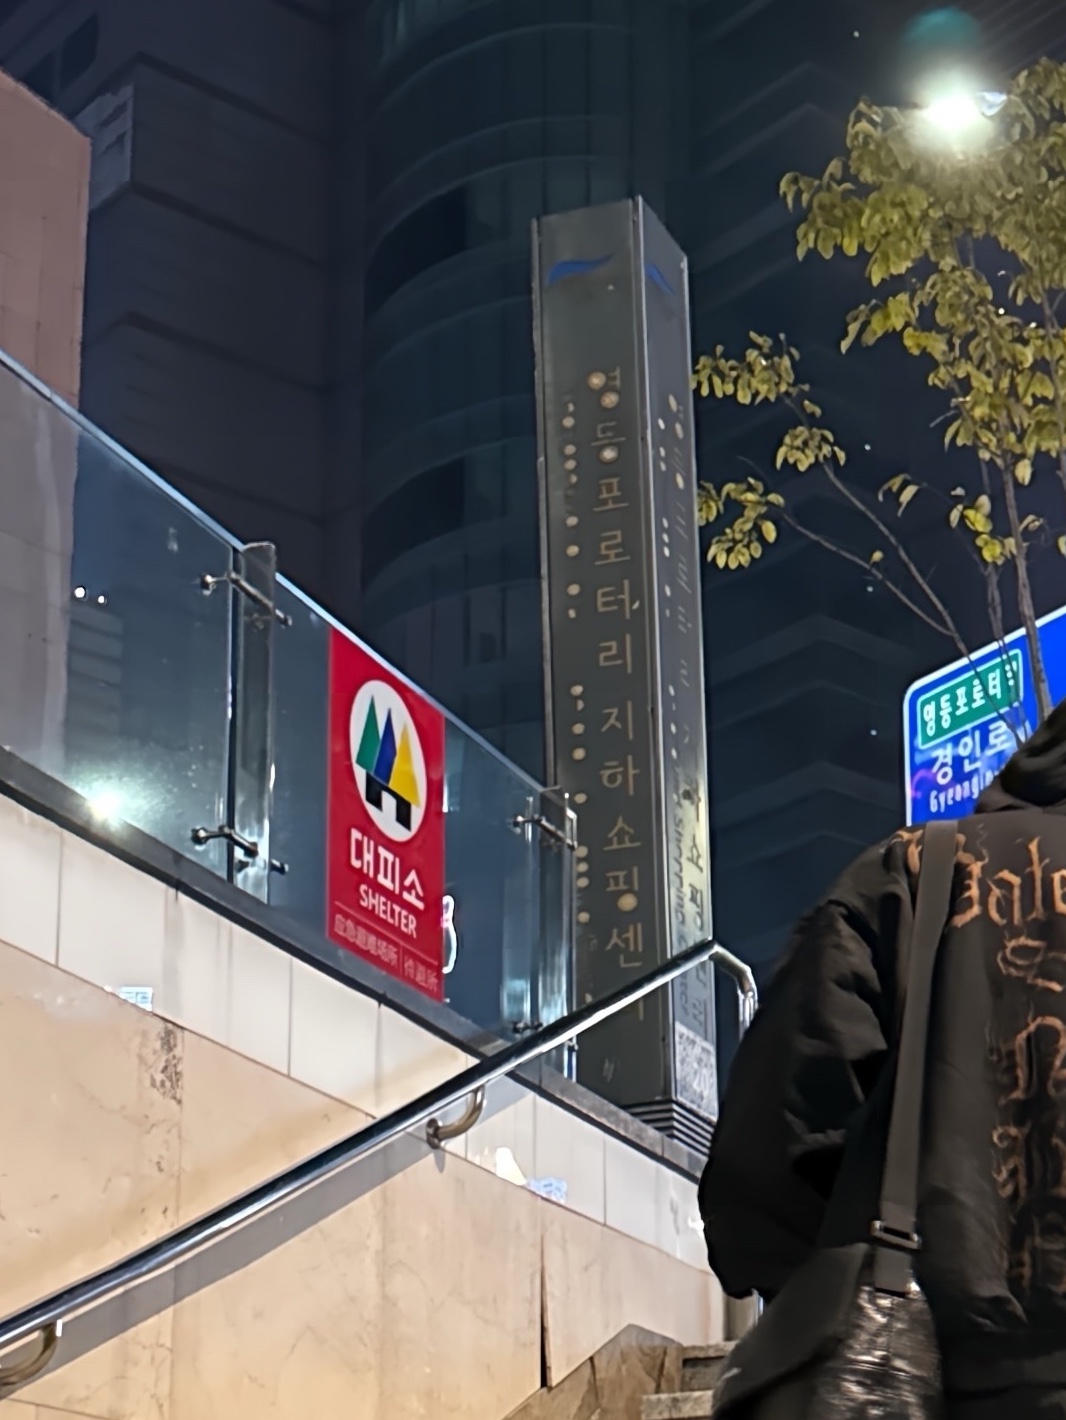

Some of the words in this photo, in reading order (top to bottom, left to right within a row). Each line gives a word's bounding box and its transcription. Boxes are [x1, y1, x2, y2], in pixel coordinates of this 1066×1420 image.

[923, 661, 1018, 737] 영등포로터리
[931, 719, 1012, 786] 경인로
[350, 827, 425, 911] 대피소
[359, 883, 417, 939] SHELTER
